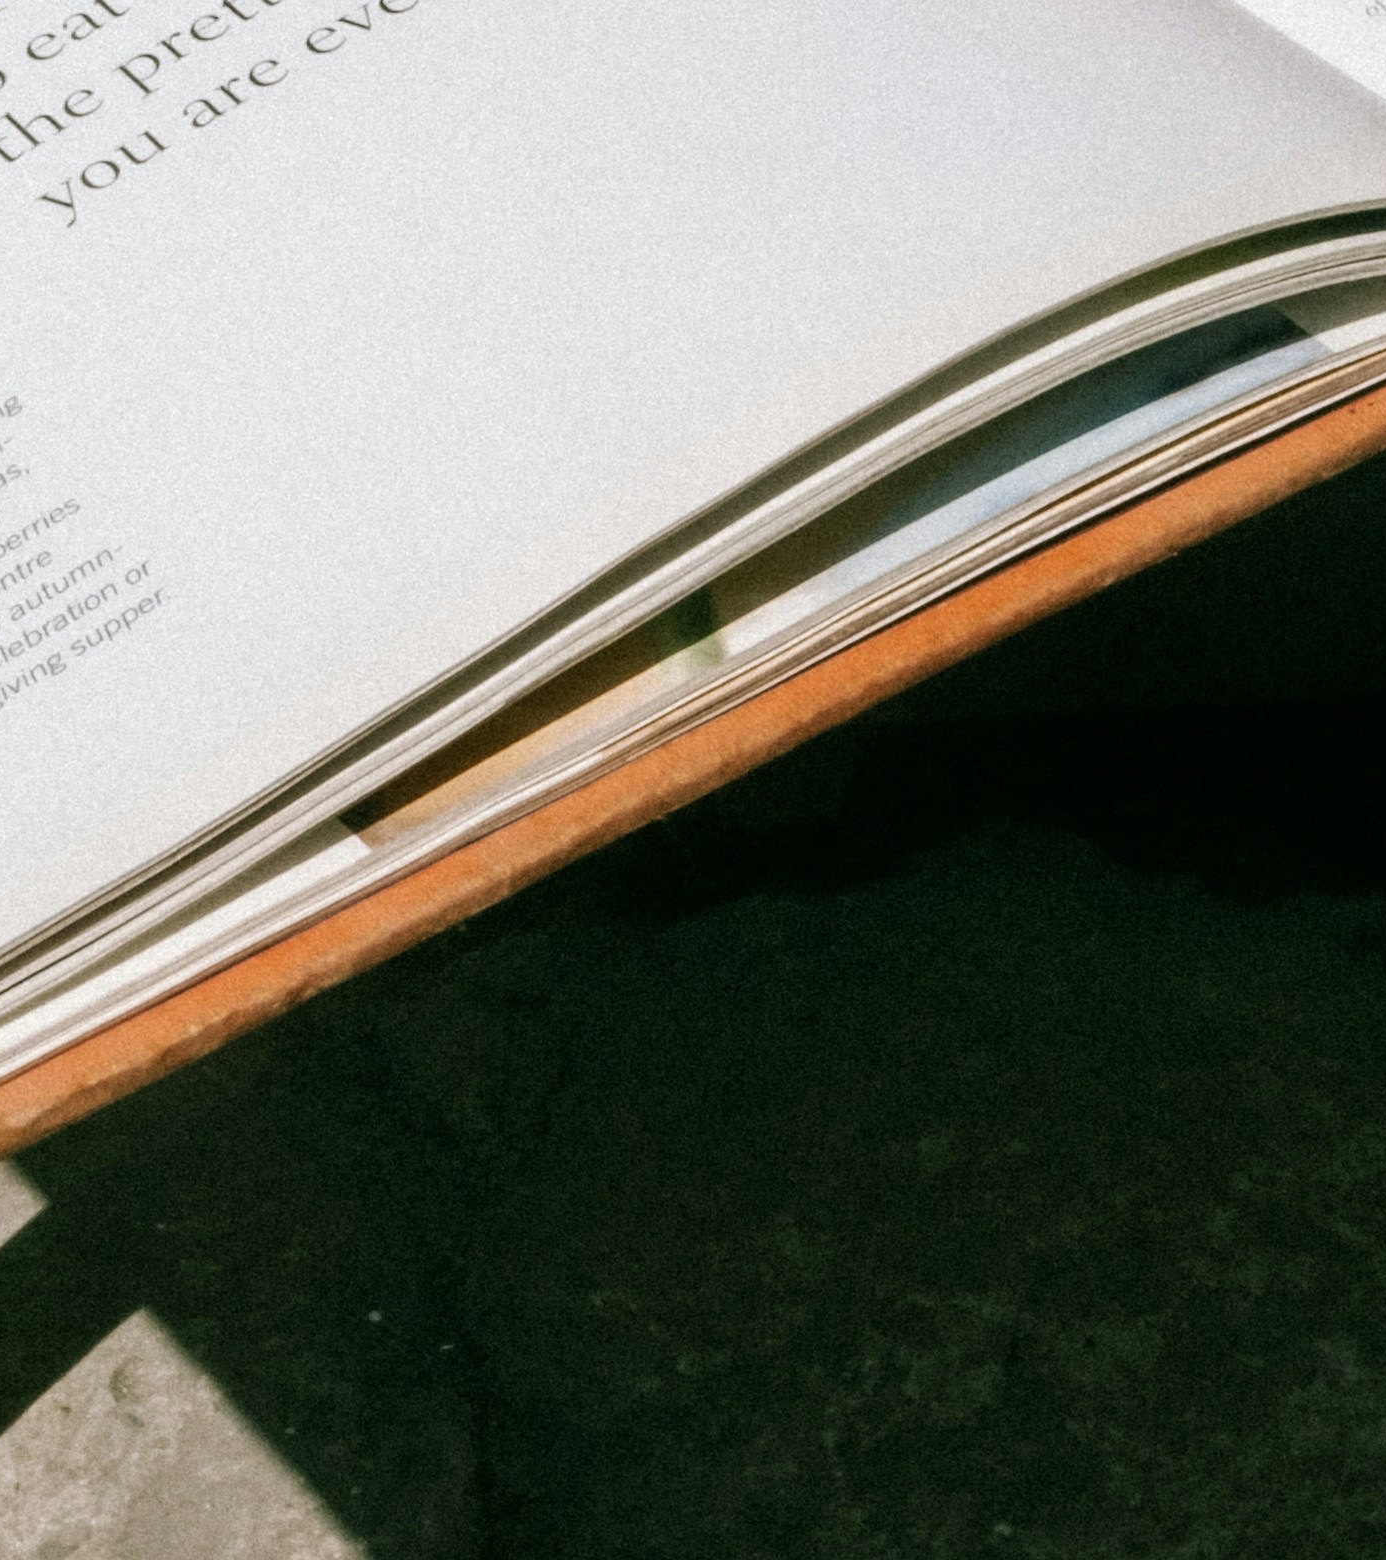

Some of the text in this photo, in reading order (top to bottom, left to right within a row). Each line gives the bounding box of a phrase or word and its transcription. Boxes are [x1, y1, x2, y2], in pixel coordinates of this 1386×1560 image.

[36, 129, 167, 228] you
[189, 57, 288, 129] are
[9, 544, 123, 622] autumn-
[123, 558, 150, 586] or
